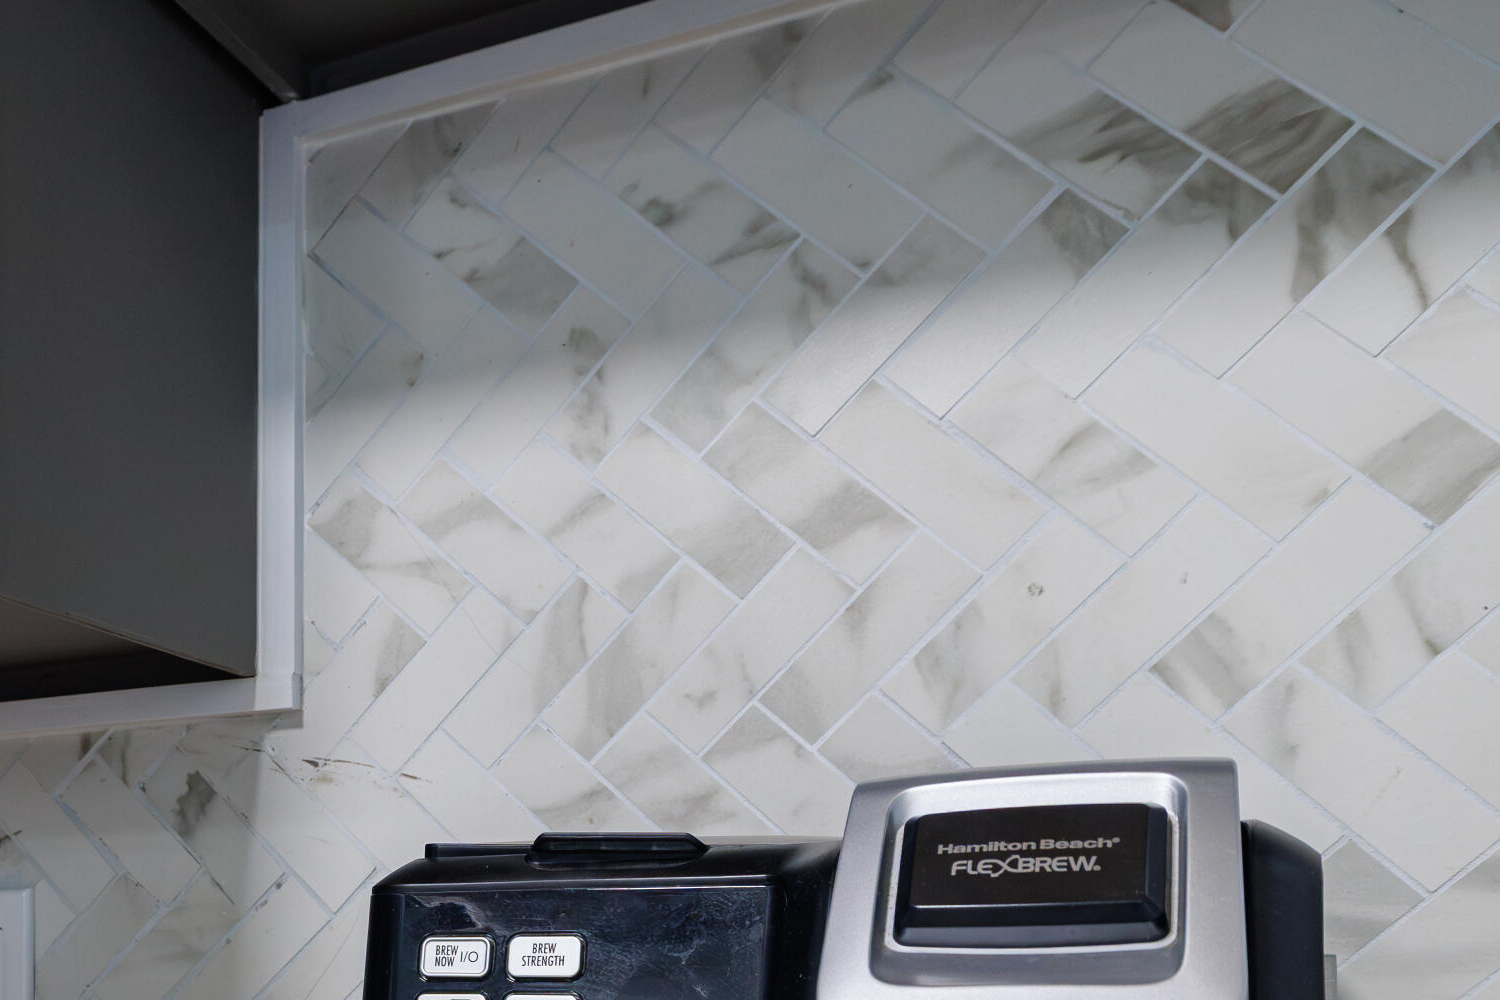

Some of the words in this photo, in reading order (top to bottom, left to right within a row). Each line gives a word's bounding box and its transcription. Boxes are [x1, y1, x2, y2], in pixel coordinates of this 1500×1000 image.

[937, 839, 1036, 855] Hamilton
[435, 944, 459, 956] BREW
[532, 942, 557, 954] BREW
[434, 956, 455, 967] NOW
[521, 954, 565, 967] STRENGTH
